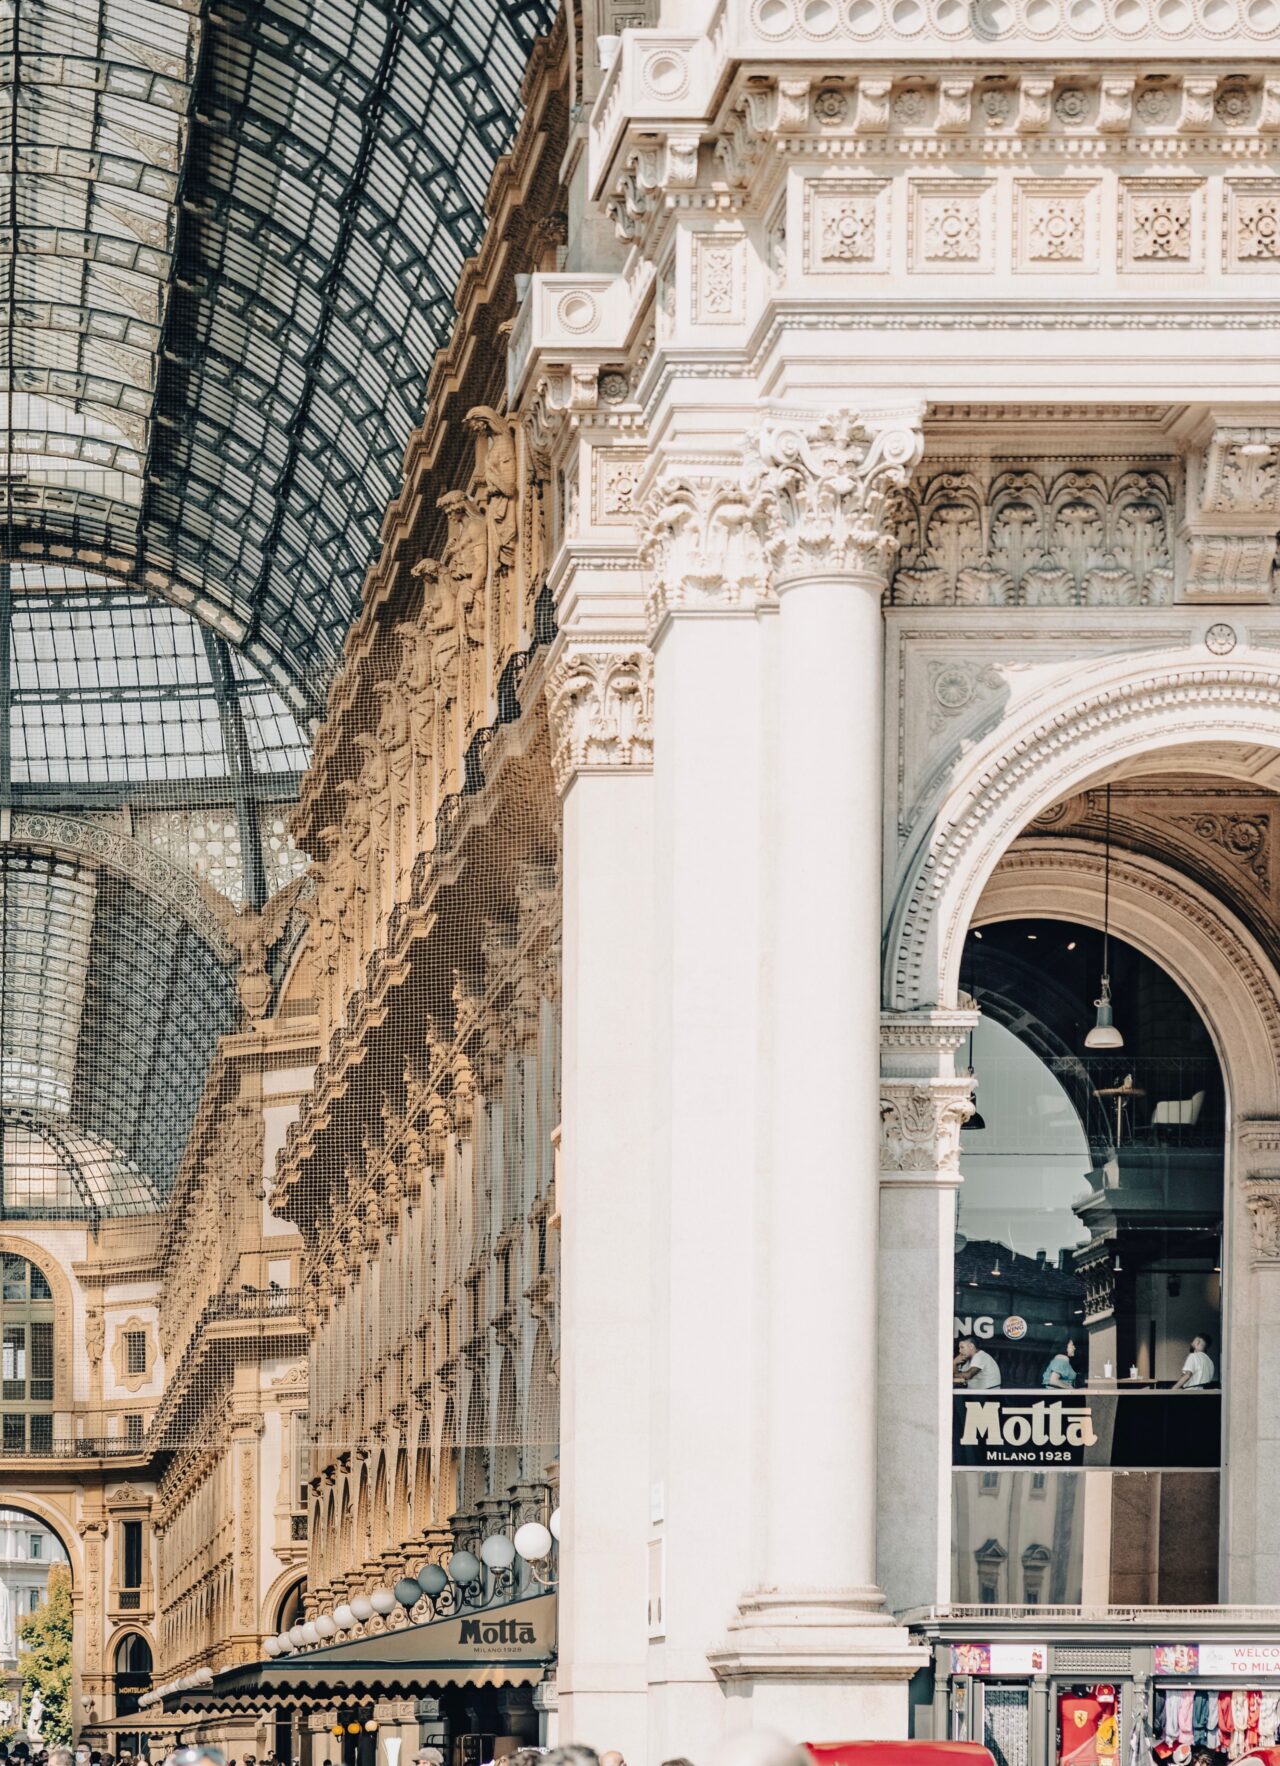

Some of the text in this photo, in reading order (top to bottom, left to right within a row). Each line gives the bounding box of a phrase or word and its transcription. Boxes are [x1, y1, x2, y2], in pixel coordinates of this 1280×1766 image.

[960, 1400, 1098, 1447] Motta
[1040, 1451, 1072, 1461] 1928
[458, 1618, 537, 1645] Motta
[1234, 1648, 1280, 1658] WELCO
[1231, 1662, 1247, 1671] TO
